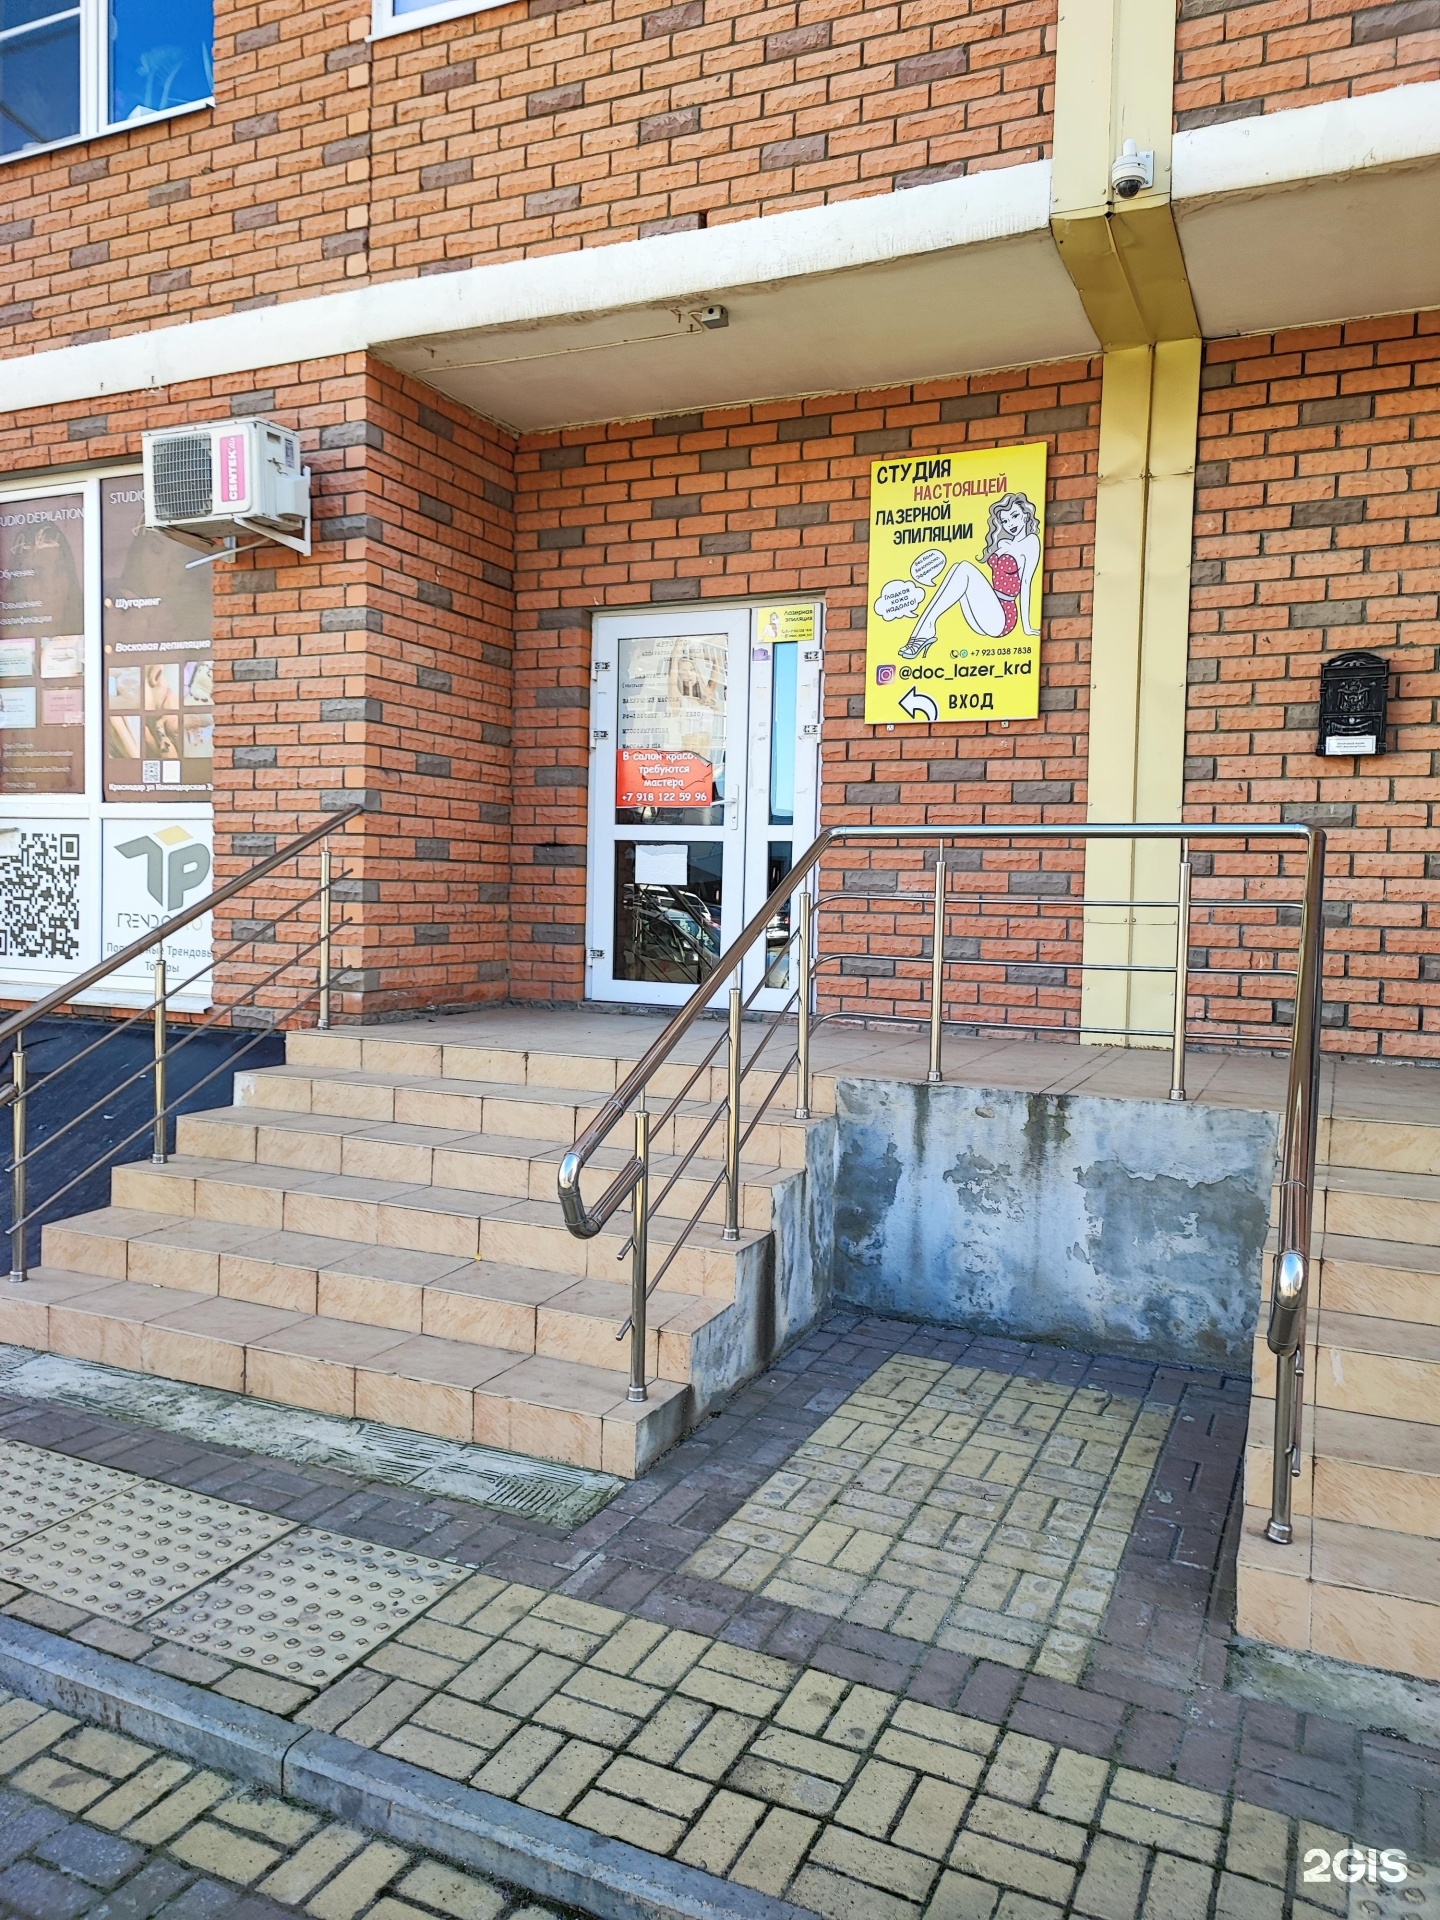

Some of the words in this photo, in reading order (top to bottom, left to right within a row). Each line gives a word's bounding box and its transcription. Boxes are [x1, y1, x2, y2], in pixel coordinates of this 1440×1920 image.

[227, 450, 238, 500] CENTEK
[877, 458, 951, 484] СТУДИЯ
[914, 473, 1008, 501] НАСТОЯЩЕЙ
[875, 500, 951, 526] ЛАЗЕРНОЙ
[0, 514, 25, 527] UDIO
[893, 523, 973, 545] ЭПИЛЯЦИИ
[884, 588, 911, 601] Гладкая
[891, 595, 909, 606] кожа
[115, 597, 161, 610] Шугаринг
[885, 598, 917, 614] надолго!
[0, 615, 53, 625] валификации
[115, 642, 159, 652] Восковая
[159, 640, 211, 652] депиляция
[970, 649, 980, 657] +7
[997, 648, 1011, 656] 038
[1012, 646, 1032, 655] 7838
[899, 660, 1032, 681] @doc_lazer_krd
[948, 692, 994, 710] ВХОД
[622, 751, 630, 761] В
[633, 752, 662, 761] салон
[666, 752, 698, 764] красо
[638, 764, 690, 776] требуются
[643, 778, 684, 789] мастера
[621, 793, 633, 802] +7
[636, 793, 654, 802] 918
[658, 793, 675, 802] 122
[679, 793, 691, 802] 59
[695, 793, 707, 802] 96
[166, 945, 213, 959] Трендовы
[145, 961, 180, 973] Торы
